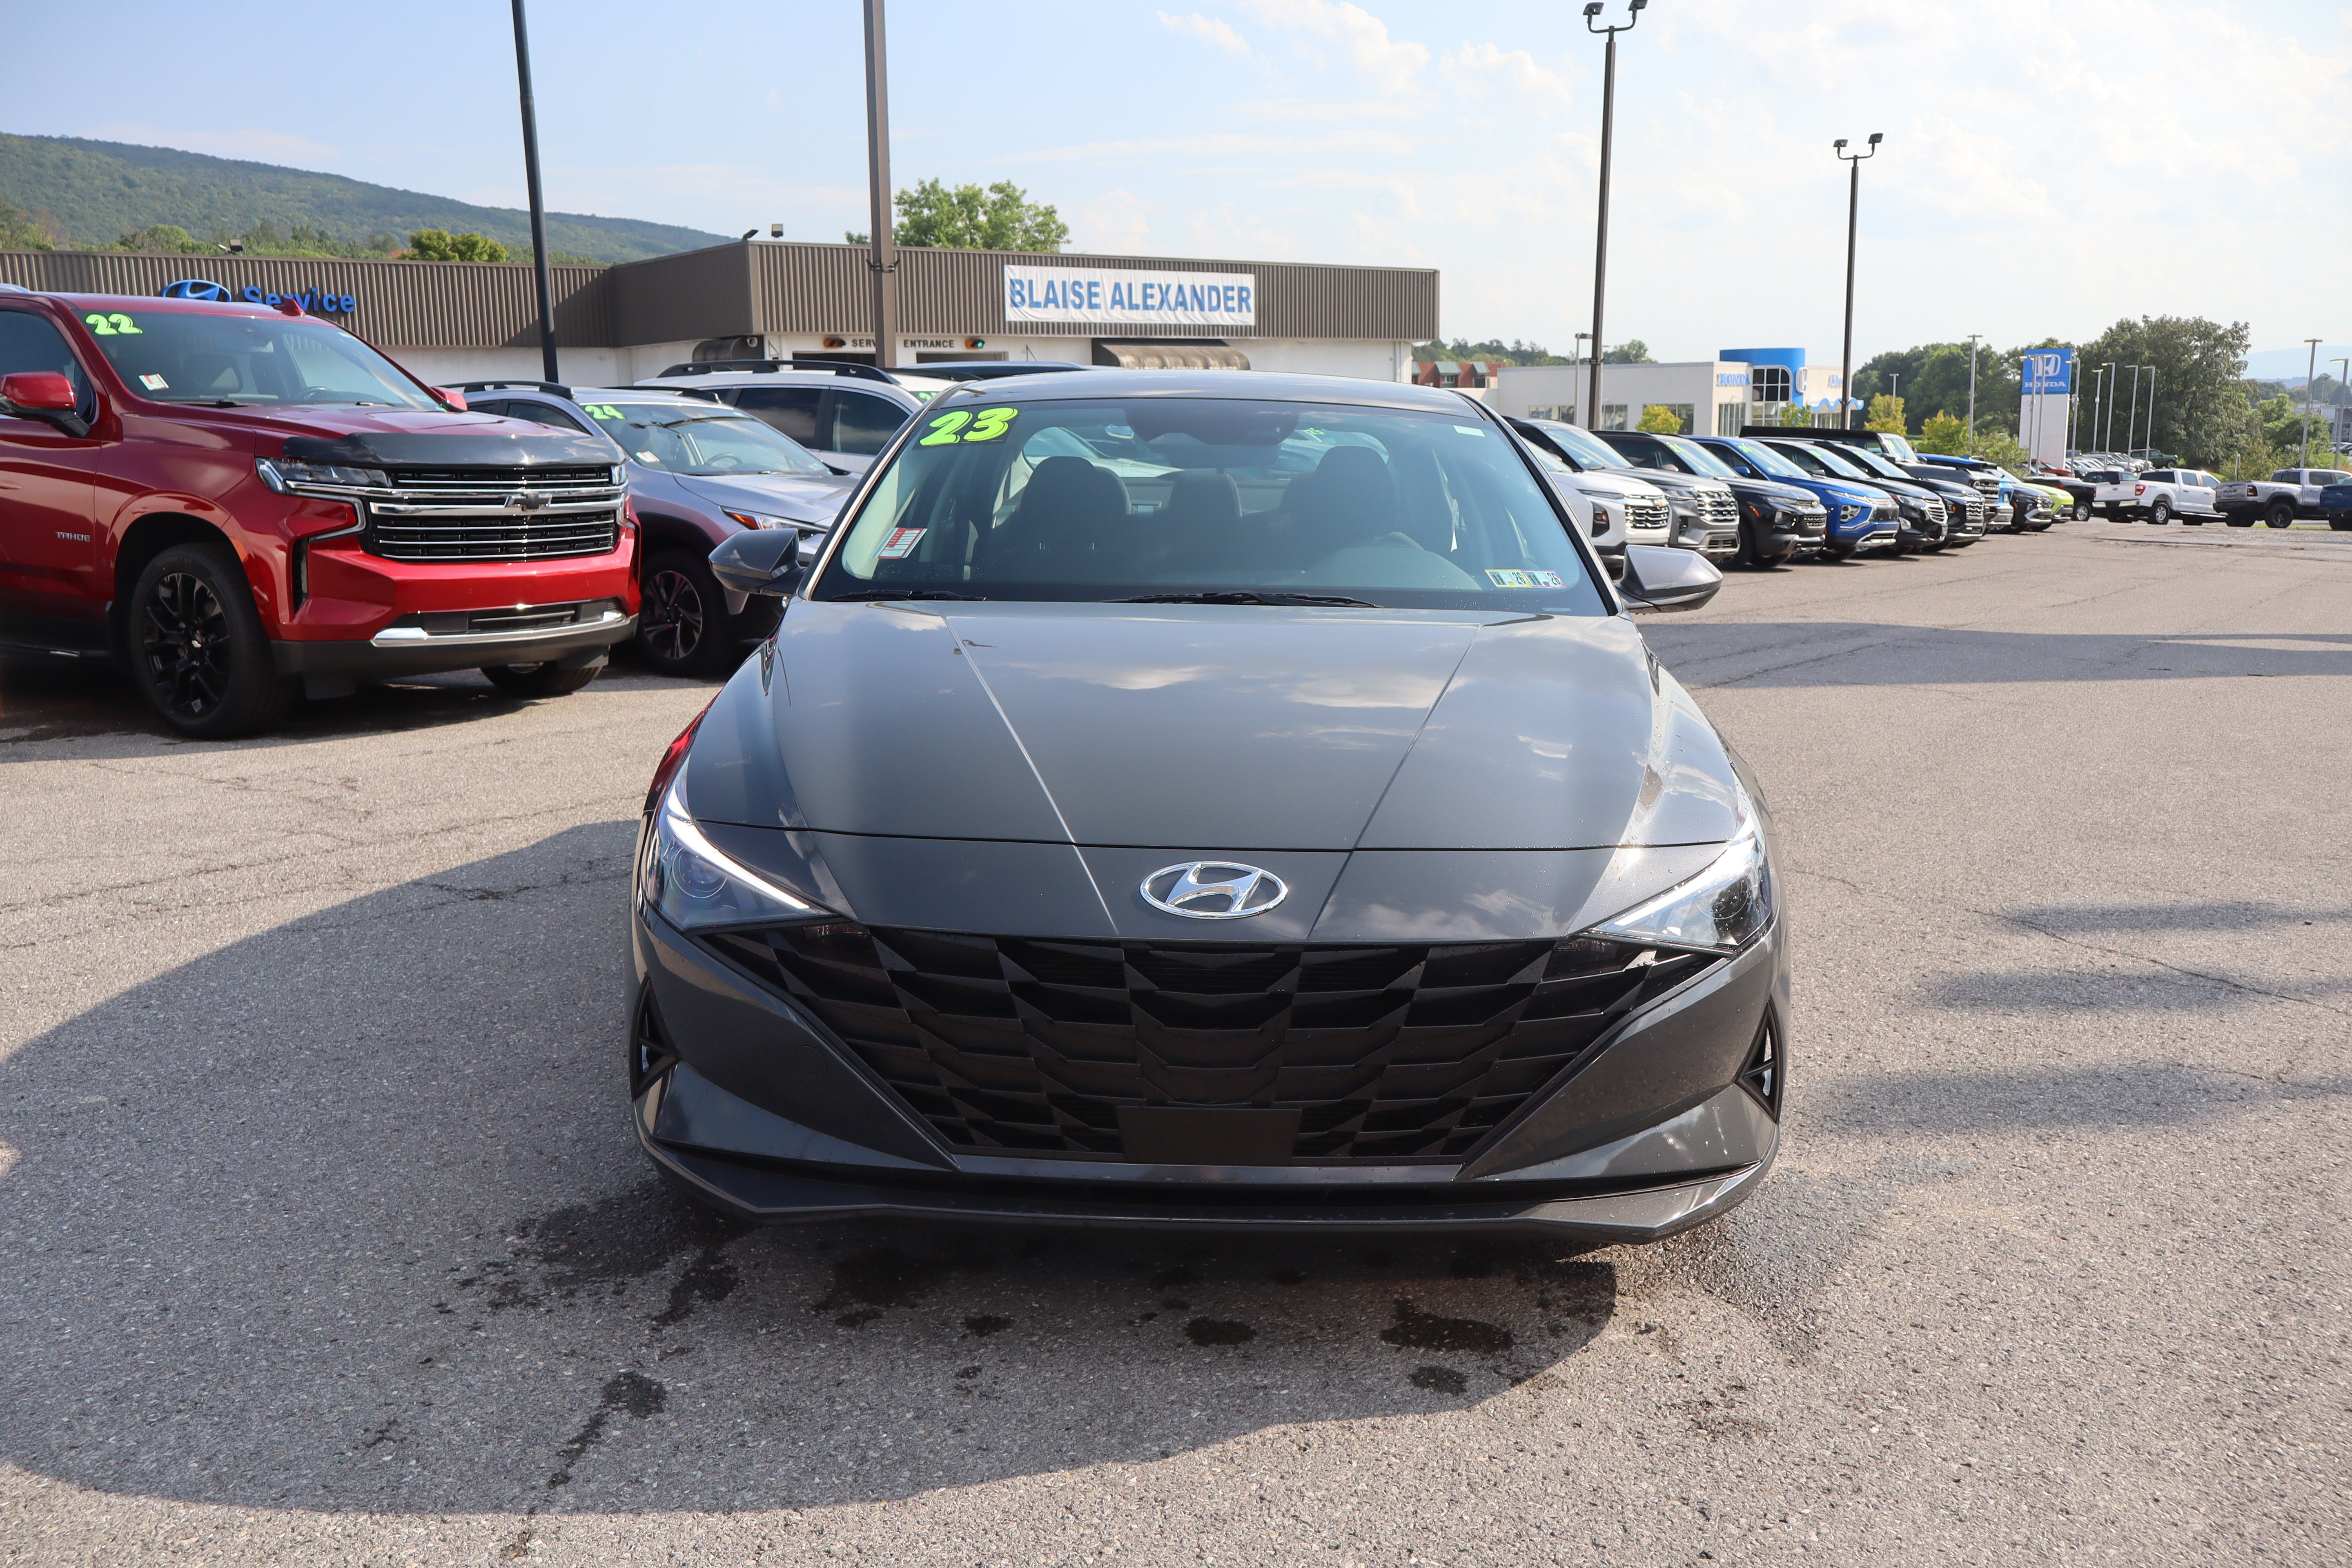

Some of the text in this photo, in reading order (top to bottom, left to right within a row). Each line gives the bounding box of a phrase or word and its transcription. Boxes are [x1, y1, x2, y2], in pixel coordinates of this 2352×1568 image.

[1010, 278, 1252, 313] BLAISE ALEXANDER
[85, 313, 143, 335] 22
[904, 339, 954, 347] ENTRANCE
[1717, 373, 1751, 385] HONDA
[584, 405, 626, 420] 24
[920, 408, 1018, 446] 23
[56, 531, 90, 542] TAHOE
[1512, 572, 1526, 585] 26
[1547, 572, 1562, 586] 26
